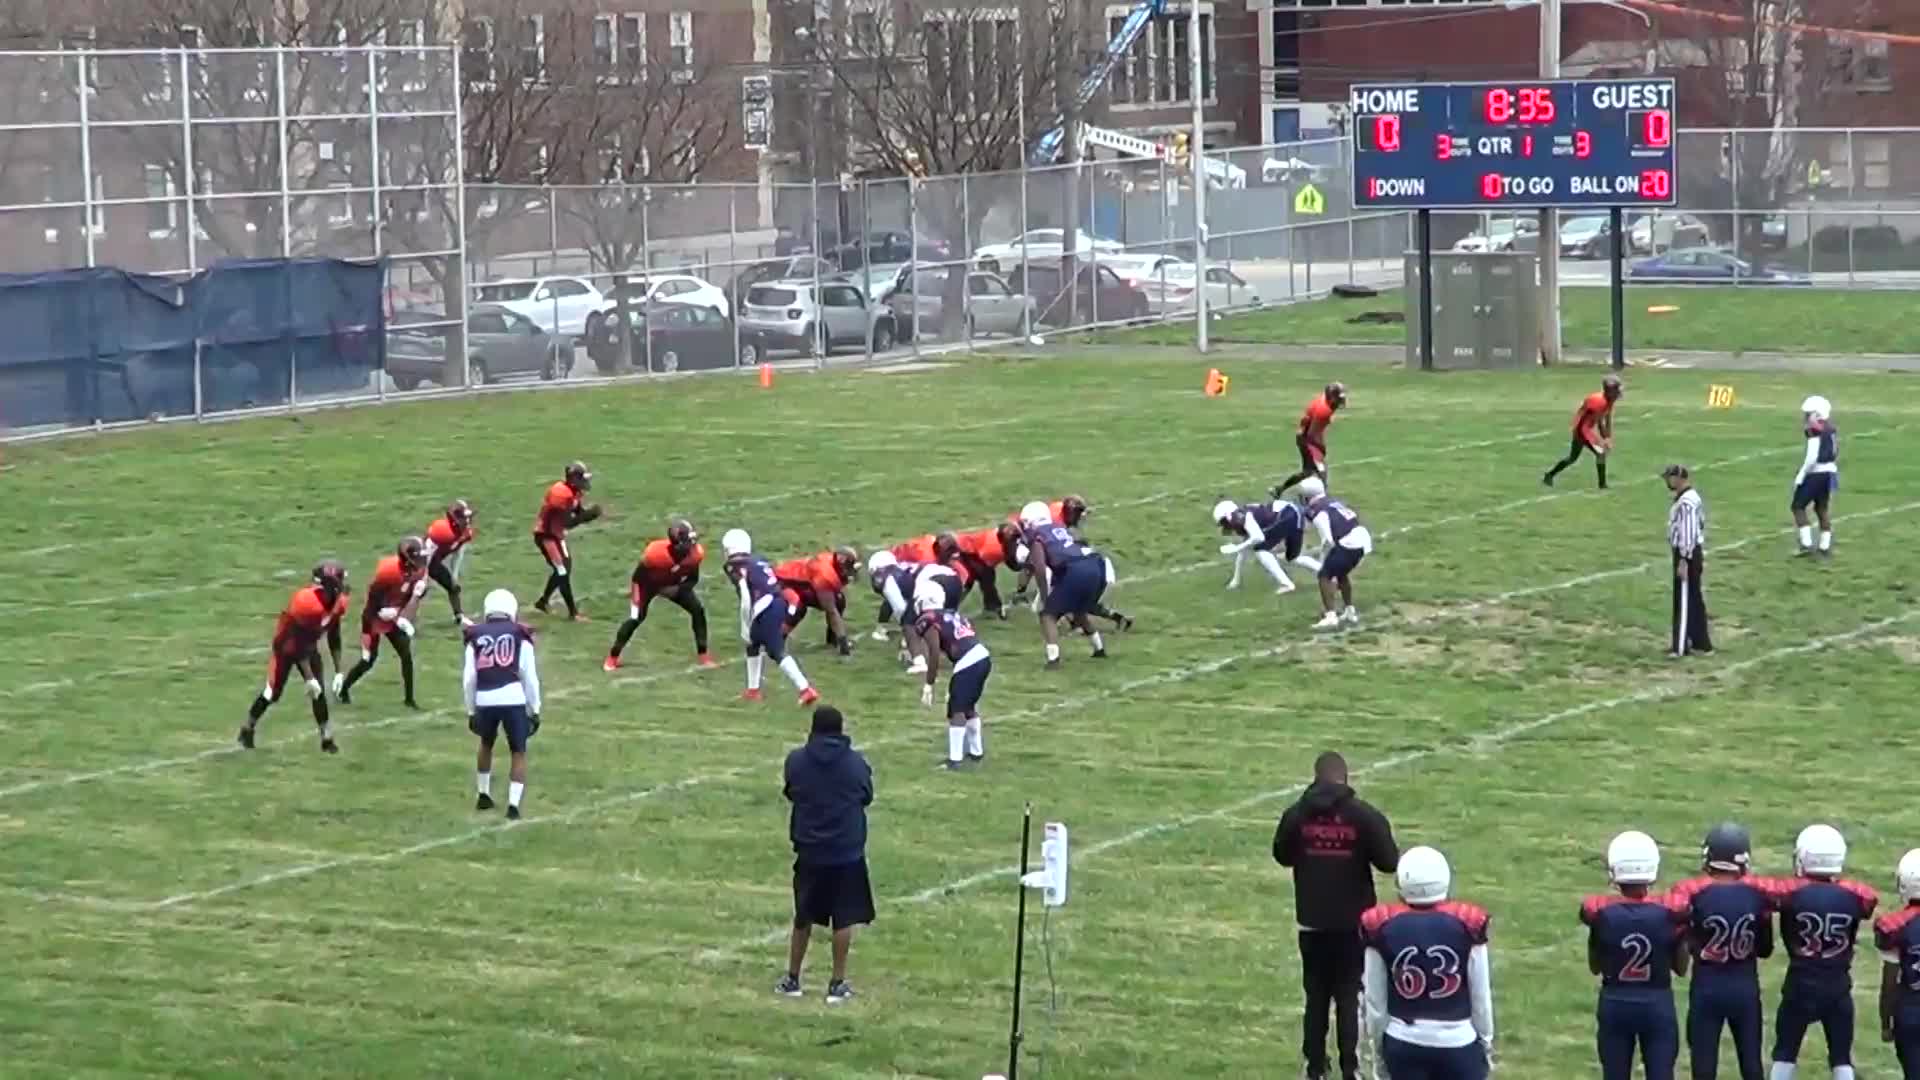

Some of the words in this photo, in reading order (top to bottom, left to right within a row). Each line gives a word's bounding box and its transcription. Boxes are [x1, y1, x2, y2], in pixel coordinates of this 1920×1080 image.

[1352, 89, 1419, 113] HOME
[1488, 88, 1554, 121] 8:35
[1592, 84, 1671, 109] GUEST
[1377, 115, 1400, 149] 0
[1647, 110, 1669, 143] 0
[1437, 133, 1451, 159] 3
[1477, 136, 1513, 155] QTR
[1524, 135, 1533, 157] 1
[1575, 131, 1591, 158] 3
[1375, 178, 1425, 196] DOWN
[1482, 173, 1502, 198] 10
[1502, 176, 1525, 194] TO
[1529, 176, 1554, 194] GO
[1570, 176, 1612, 193] BALL
[1615, 175, 1639, 193] ON
[1641, 169, 1669, 197] 20
[1712, 386, 1730, 407] 10
[476, 633, 515, 670] 20
[1699, 914, 1756, 963] 26
[1796, 912, 1852, 958] 35
[1618, 933, 1652, 981] 2
[1392, 944, 1462, 999] 63
